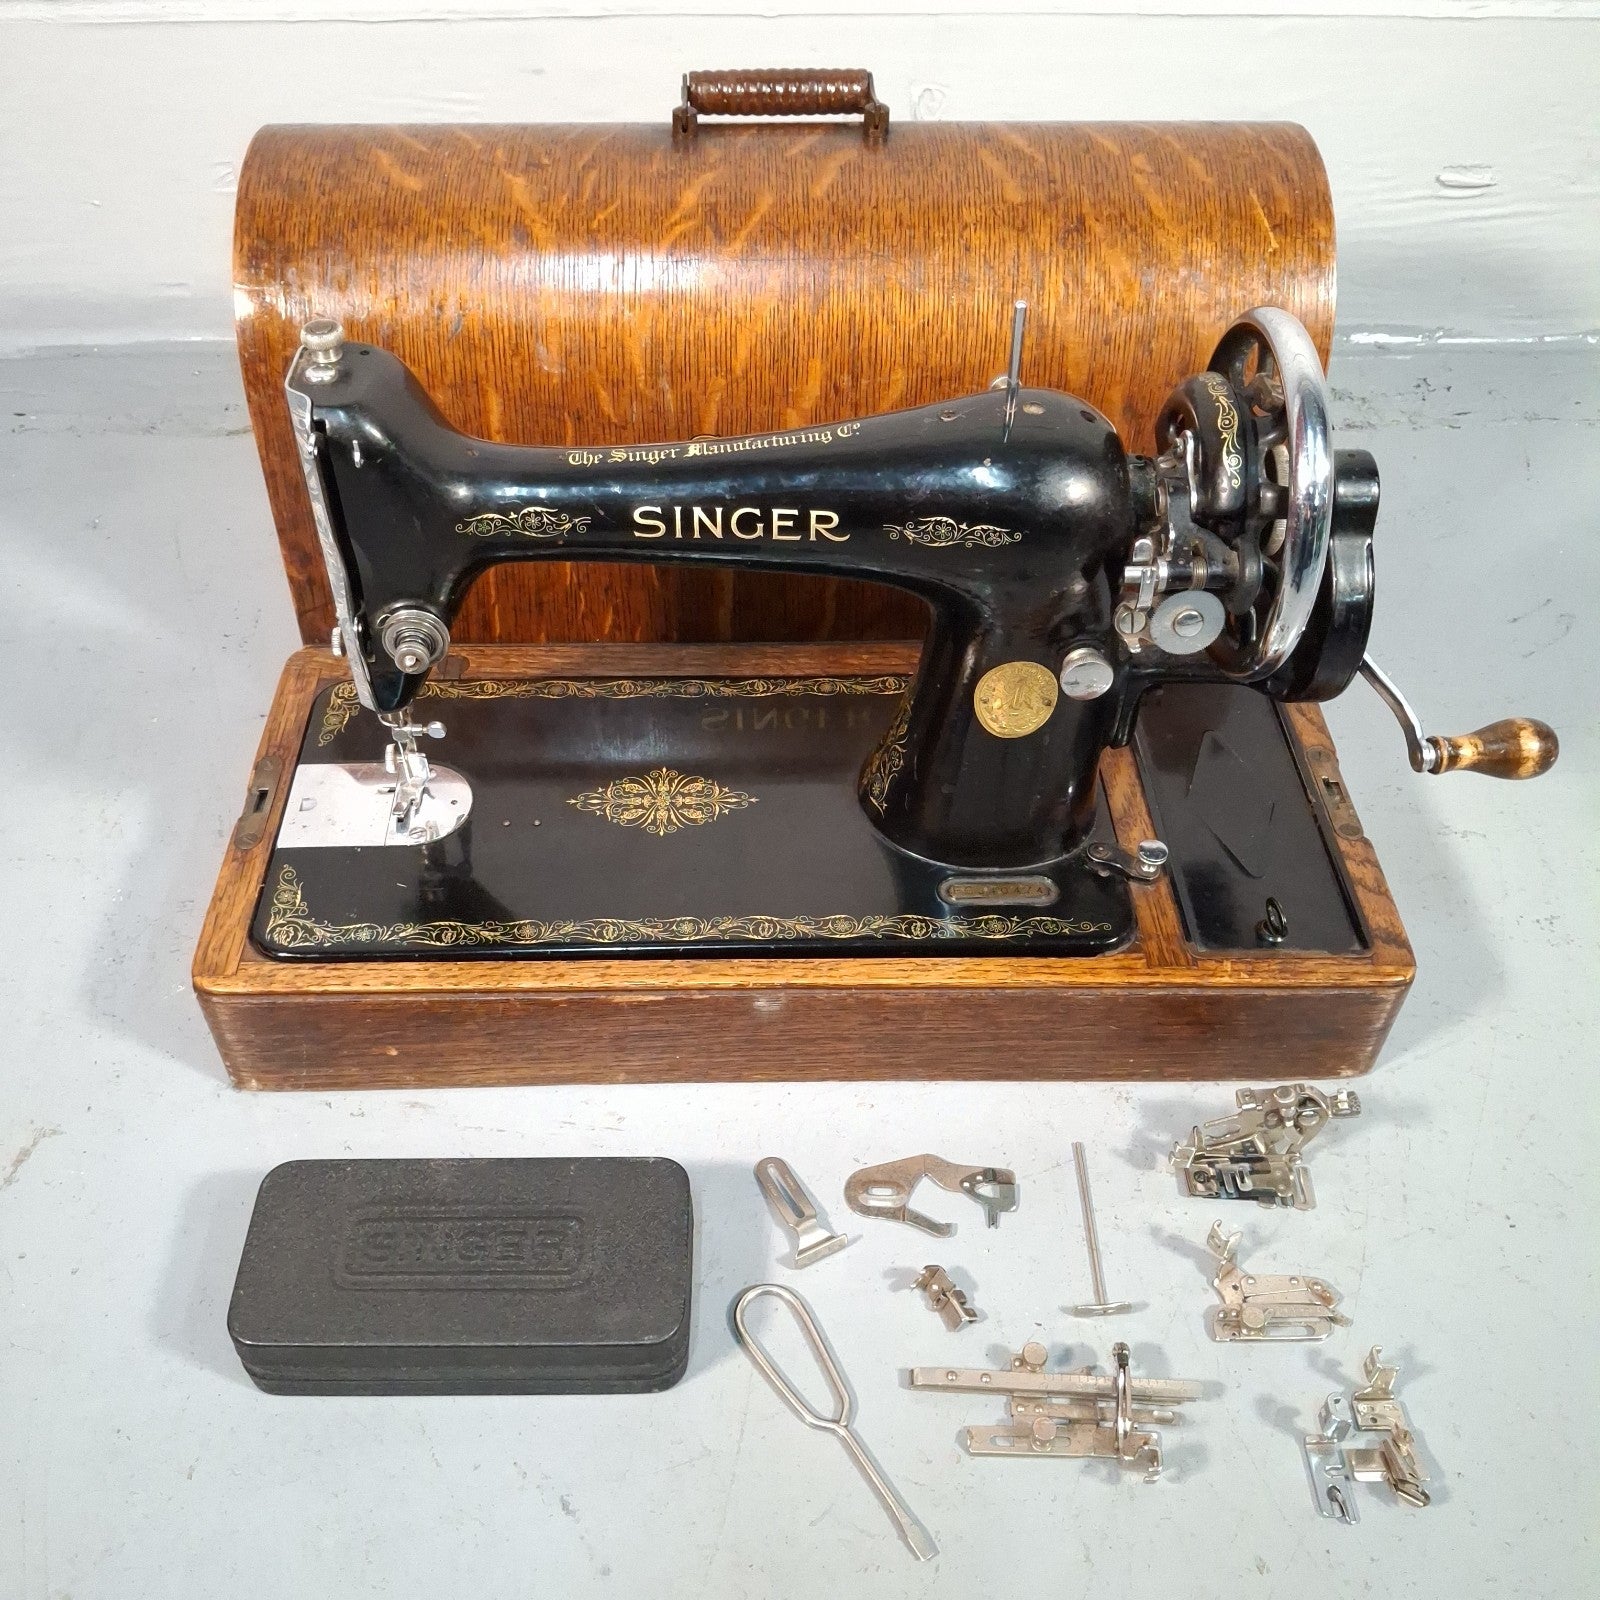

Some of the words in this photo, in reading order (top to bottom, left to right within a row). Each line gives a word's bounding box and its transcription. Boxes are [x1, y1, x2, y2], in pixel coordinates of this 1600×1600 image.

[568, 449, 602, 468] The
[608, 447, 680, 465] Singer
[683, 430, 833, 459] Manufacturing
[633, 505, 851, 543] SINGER
